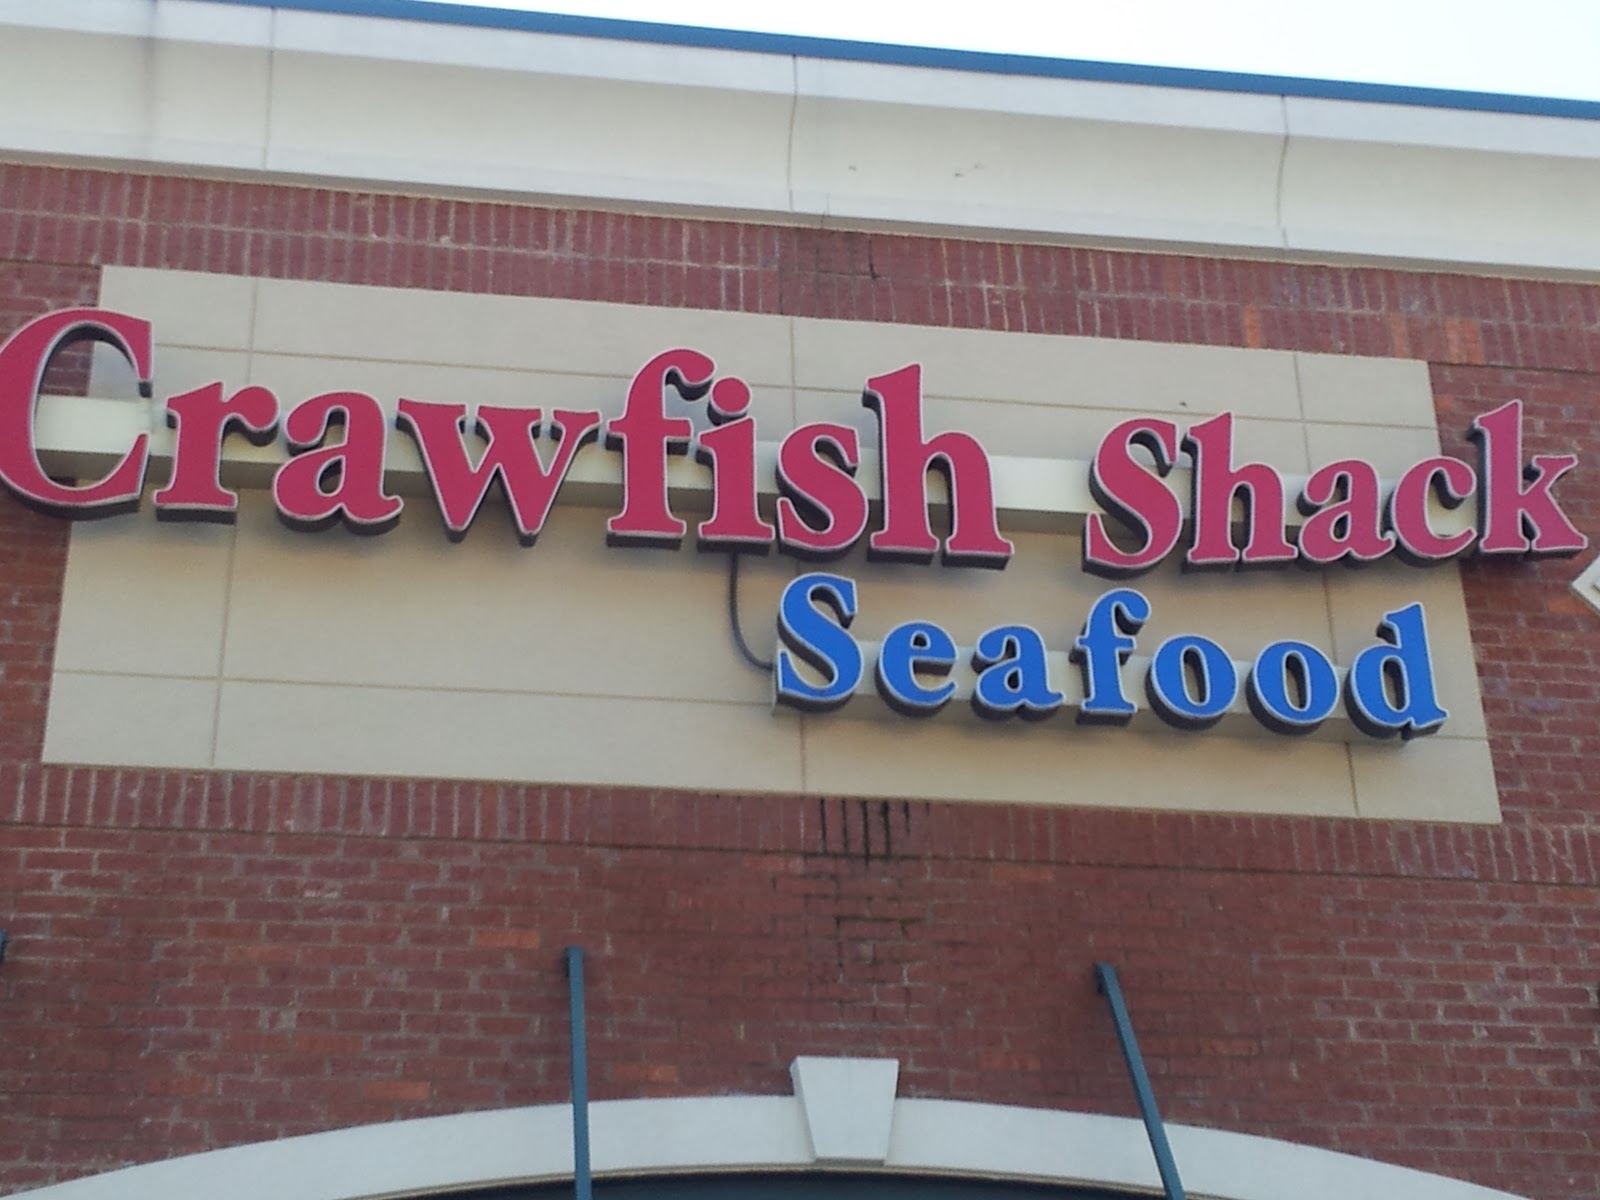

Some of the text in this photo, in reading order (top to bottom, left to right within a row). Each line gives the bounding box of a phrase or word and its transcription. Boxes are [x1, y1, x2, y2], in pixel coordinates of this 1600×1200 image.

[0, 306, 1588, 572] Crawfish Shack
[776, 572, 1449, 734] Seafood
